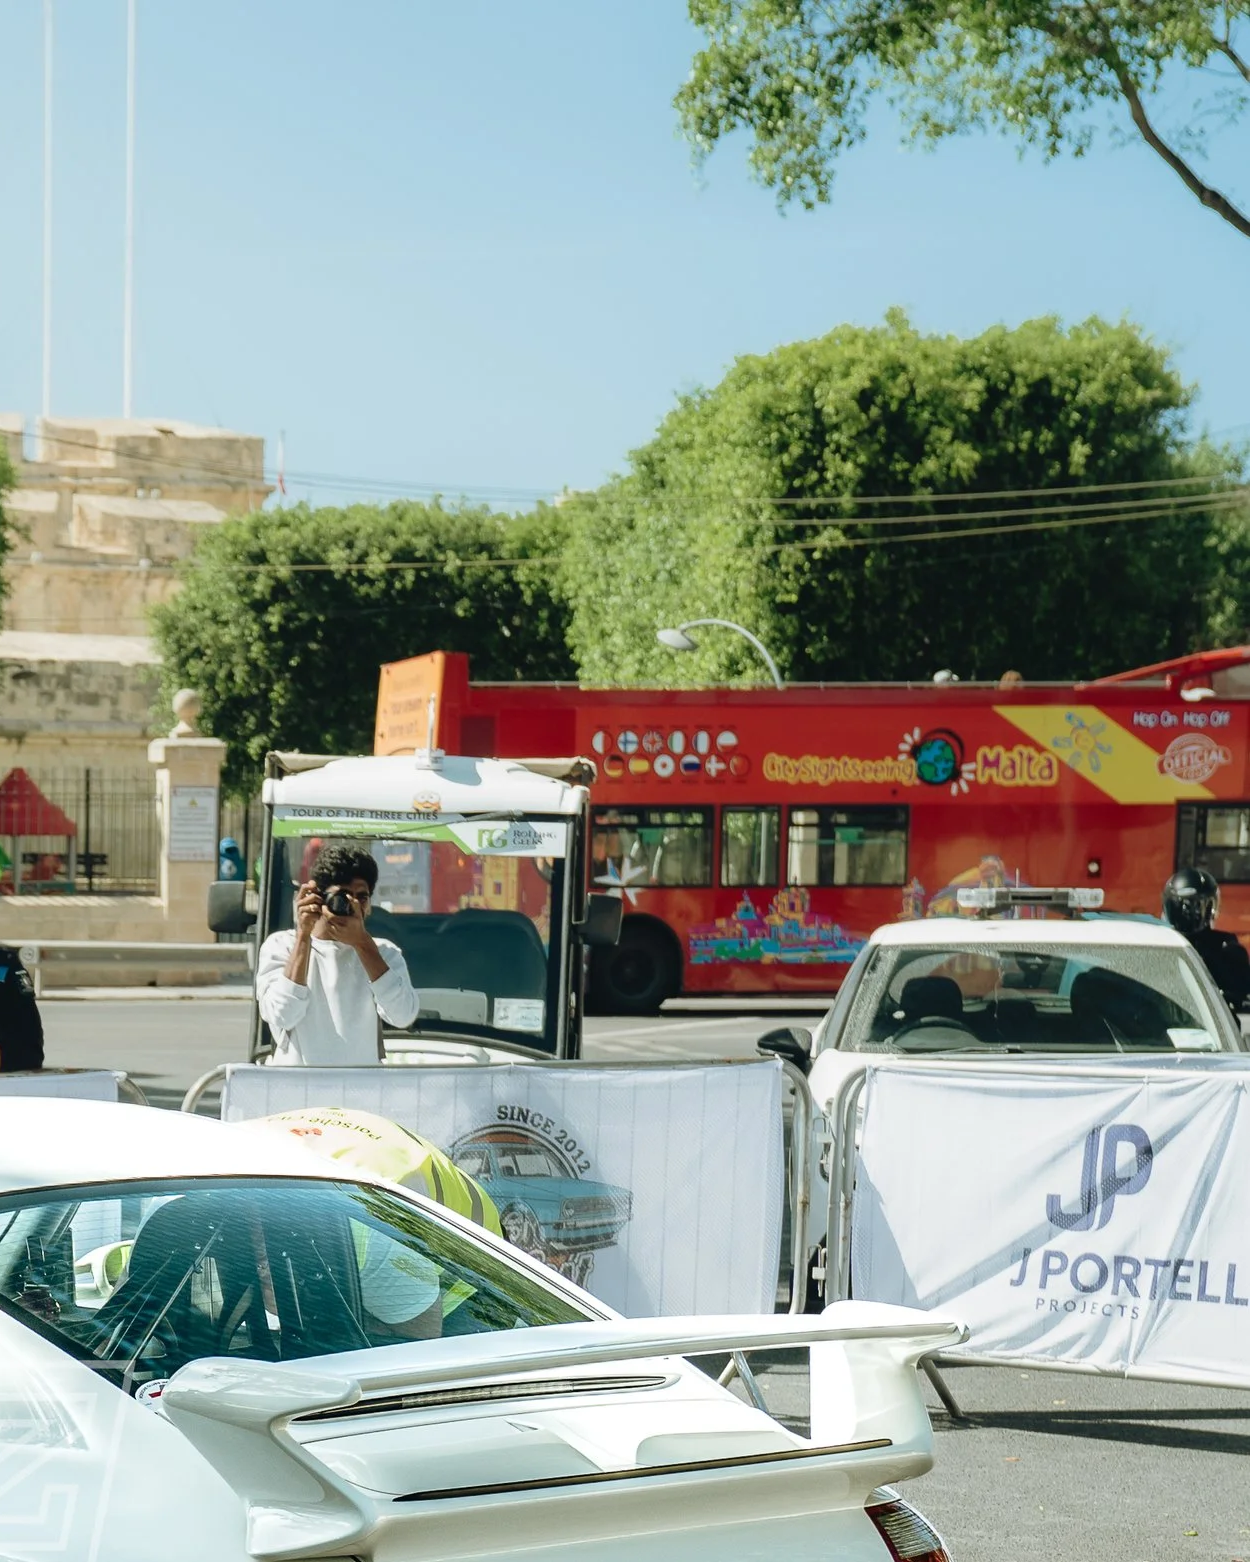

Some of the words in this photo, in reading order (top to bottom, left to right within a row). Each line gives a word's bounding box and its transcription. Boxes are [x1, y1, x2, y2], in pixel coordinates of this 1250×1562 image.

[1133, 711, 1159, 728] Hop
[1160, 710, 1178, 728] On
[1183, 711, 1208, 728] Hop
[1210, 710, 1230, 728] Off
[977, 745, 1057, 785] Malta
[1163, 748, 1229, 773] OFFICIAL
[291, 808, 322, 817] TOUR
[326, 808, 342, 818] OF
[345, 810, 365, 819] THE
[369, 811, 403, 820] THREE
[406, 812, 439, 821] CITIES
[496, 1104, 556, 1133] SINCE
[554, 1129, 591, 1174] 2012
[1045, 1123, 1154, 1232] JP
[1009, 1247, 1032, 1287] J
[1038, 1250, 1249, 1306] PORTELL
[1035, 1298, 1140, 1321] PROJECTS
